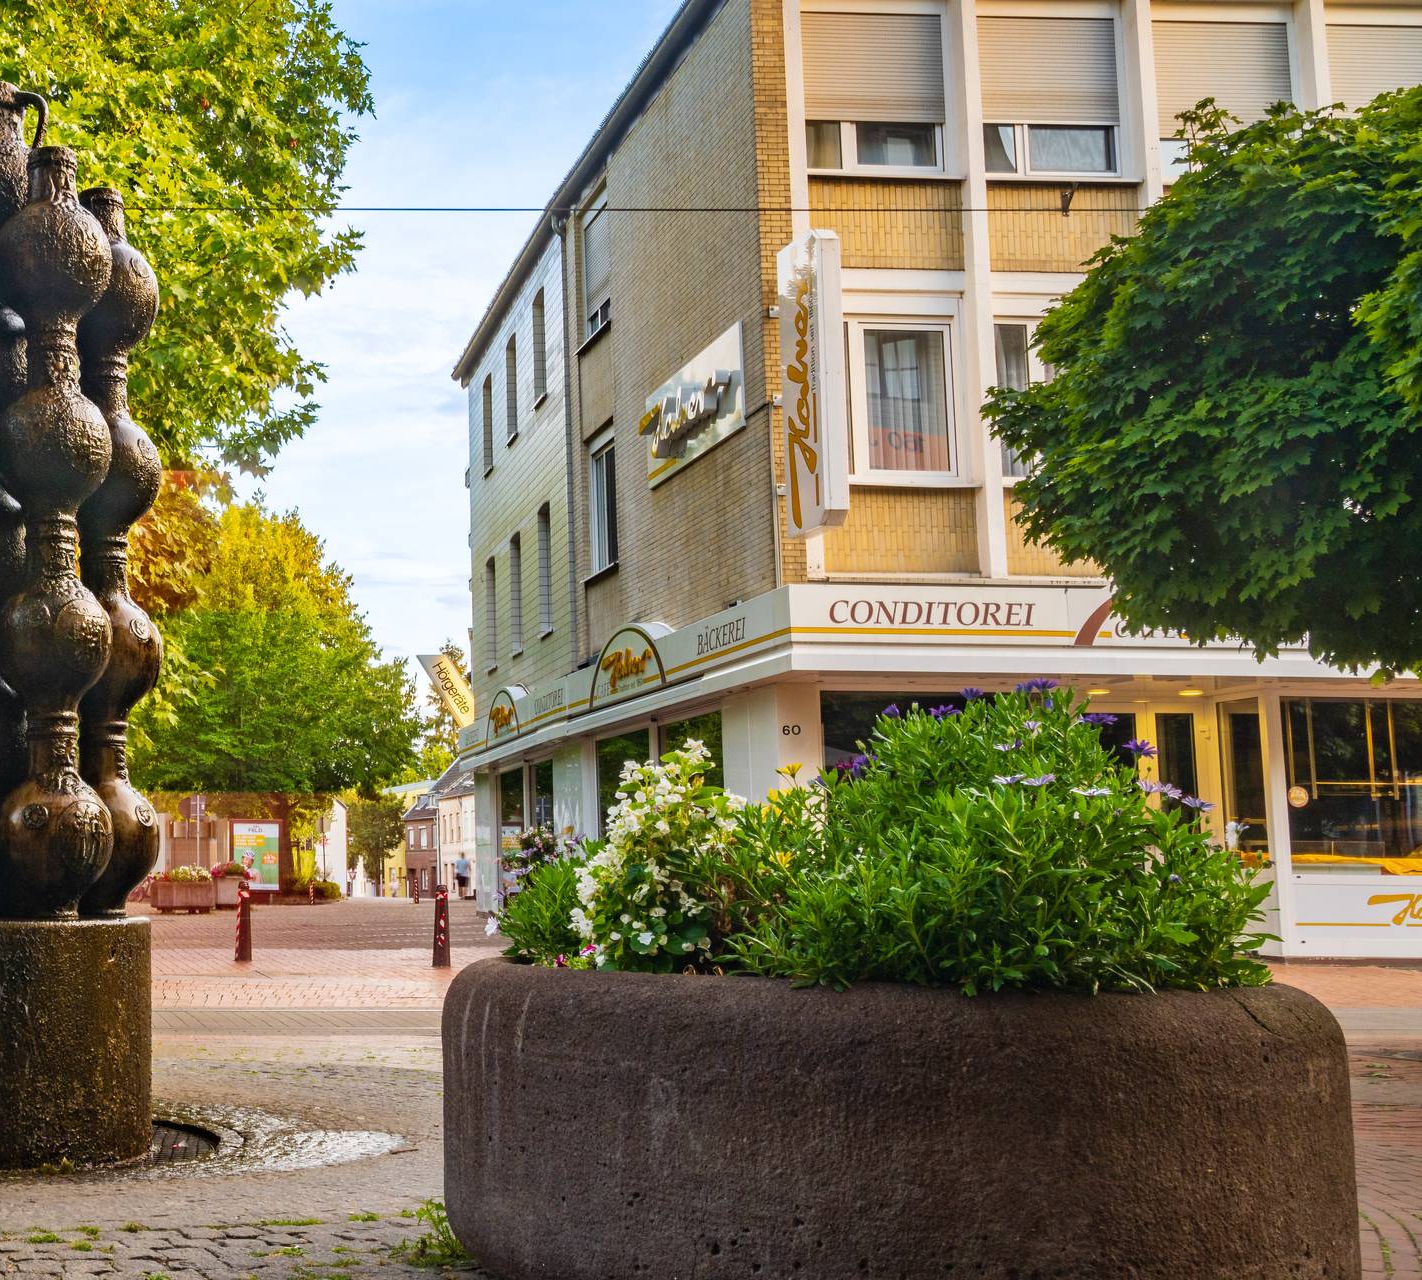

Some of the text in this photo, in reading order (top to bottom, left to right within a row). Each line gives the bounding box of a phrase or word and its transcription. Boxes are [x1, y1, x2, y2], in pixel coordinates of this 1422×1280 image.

[829, 599, 1036, 627] CONDITOREI
[696, 616, 746, 657] BÄCKEREI
[432, 661, 469, 714] Hörgeräte
[782, 725, 801, 735] 60
